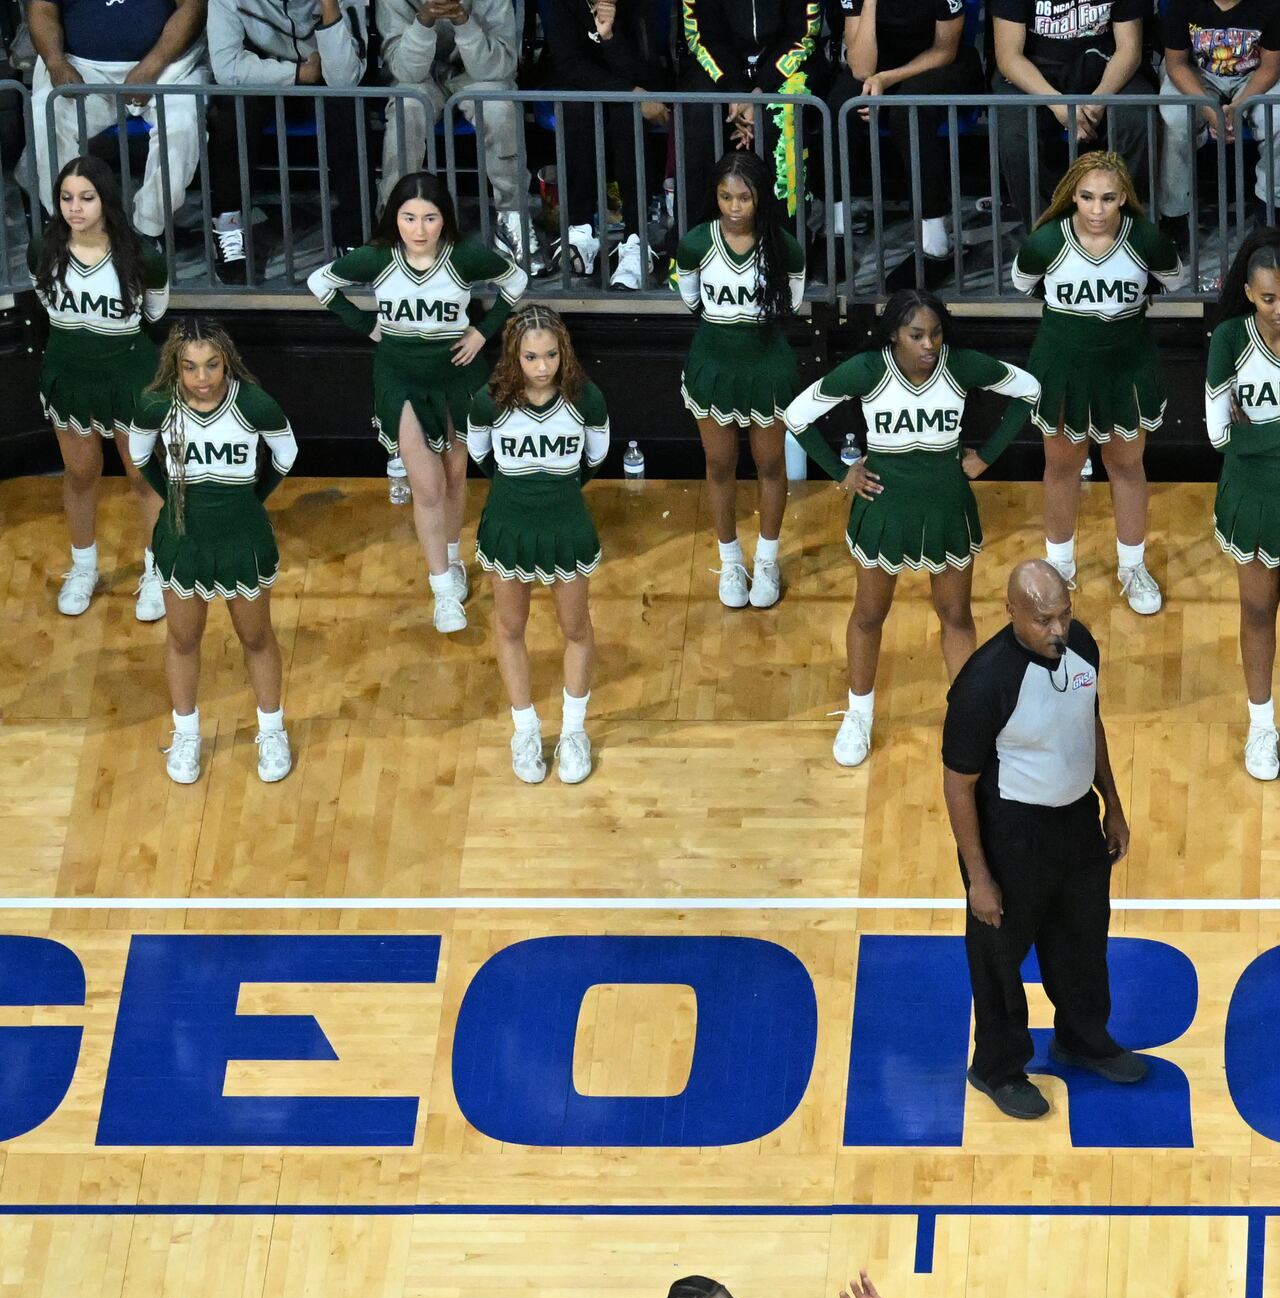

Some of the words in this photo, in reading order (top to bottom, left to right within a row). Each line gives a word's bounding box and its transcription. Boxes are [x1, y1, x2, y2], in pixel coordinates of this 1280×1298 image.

[1035, 15, 1077, 34] Final
[703, 283, 768, 305] RAM
[1057, 279, 1139, 304] RAMS
[378, 299, 460, 322] RAMS
[875, 408, 959, 433] RAMS
[500, 435, 580, 457] RAMS
